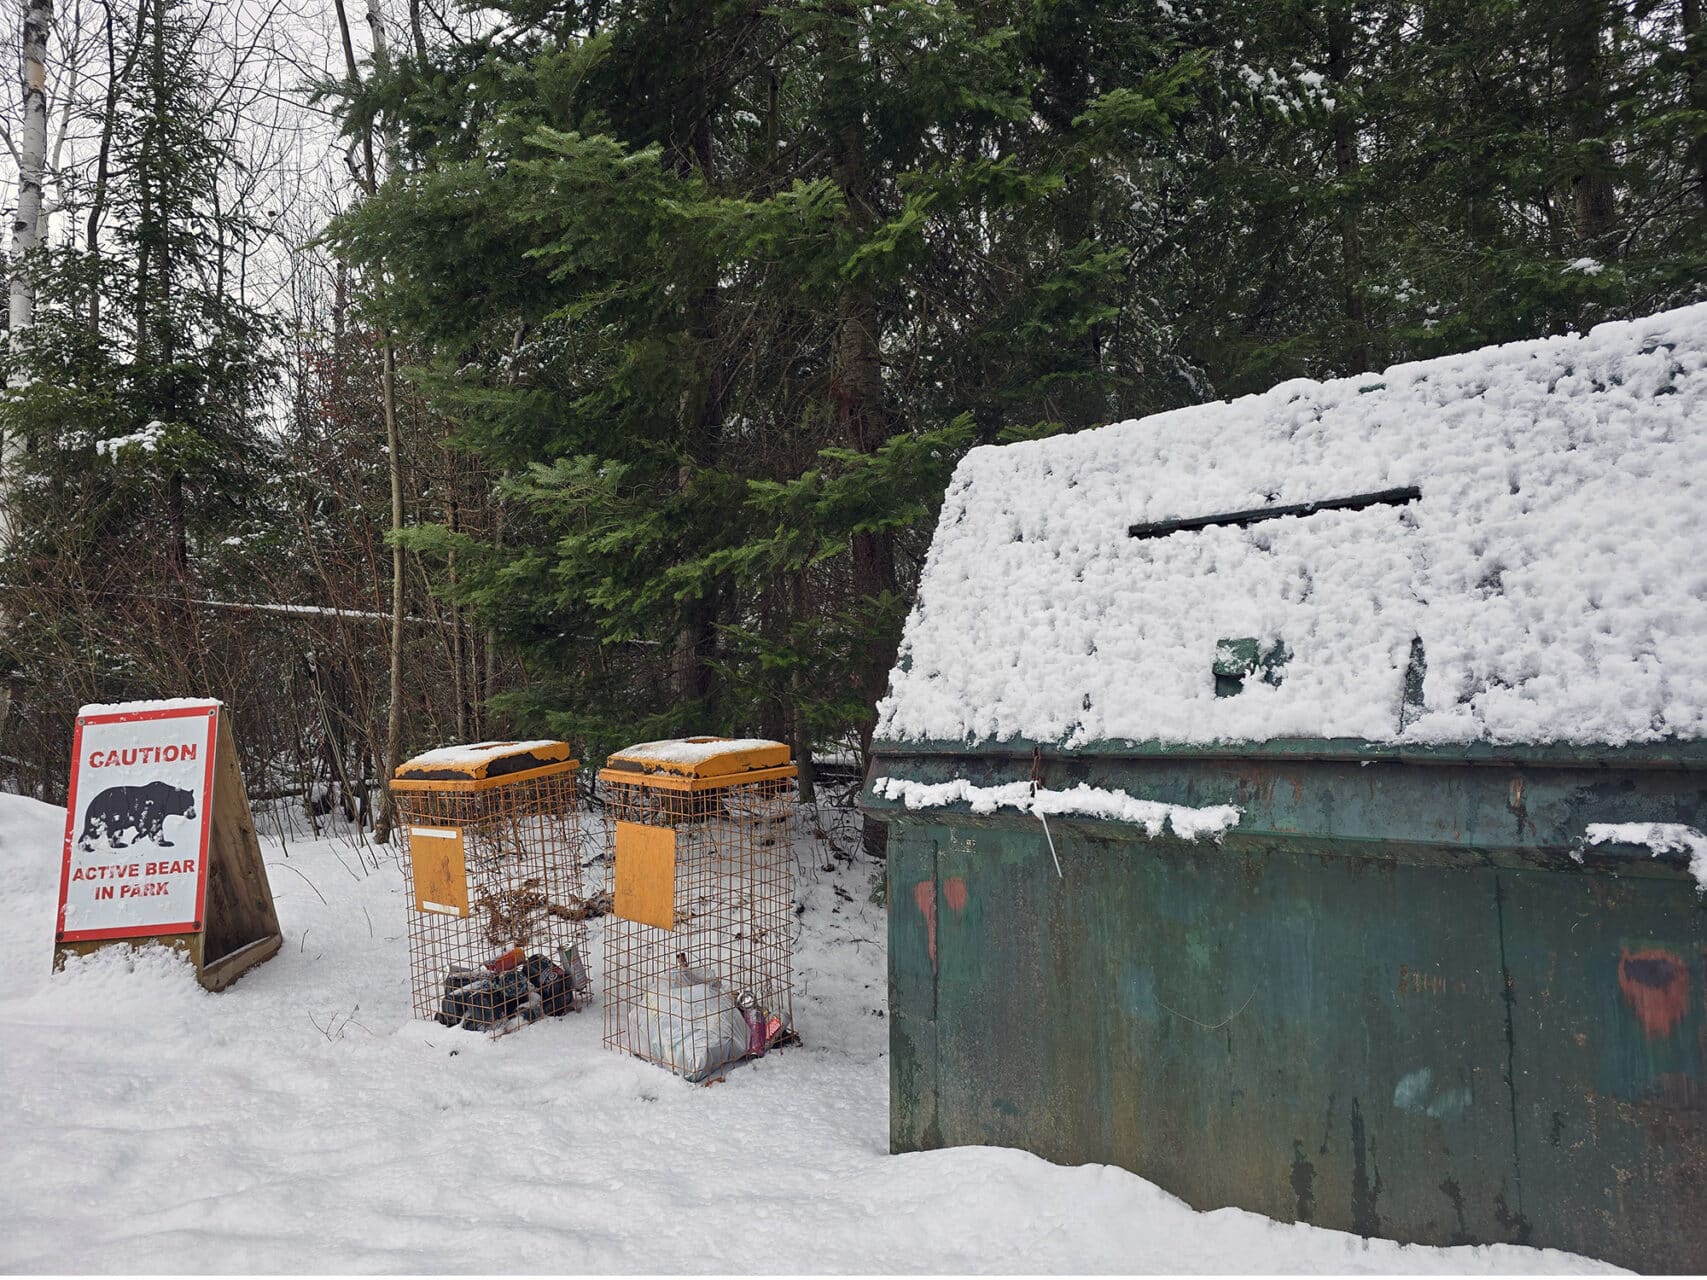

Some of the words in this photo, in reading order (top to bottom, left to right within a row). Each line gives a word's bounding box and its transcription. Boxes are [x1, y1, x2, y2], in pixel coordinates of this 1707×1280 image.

[89, 744, 198, 768] CAUTION
[72, 863, 139, 882] ACTIVE
[146, 859, 195, 876] BEAR
[95, 886, 114, 900] IN
[120, 882, 169, 898] PARK
